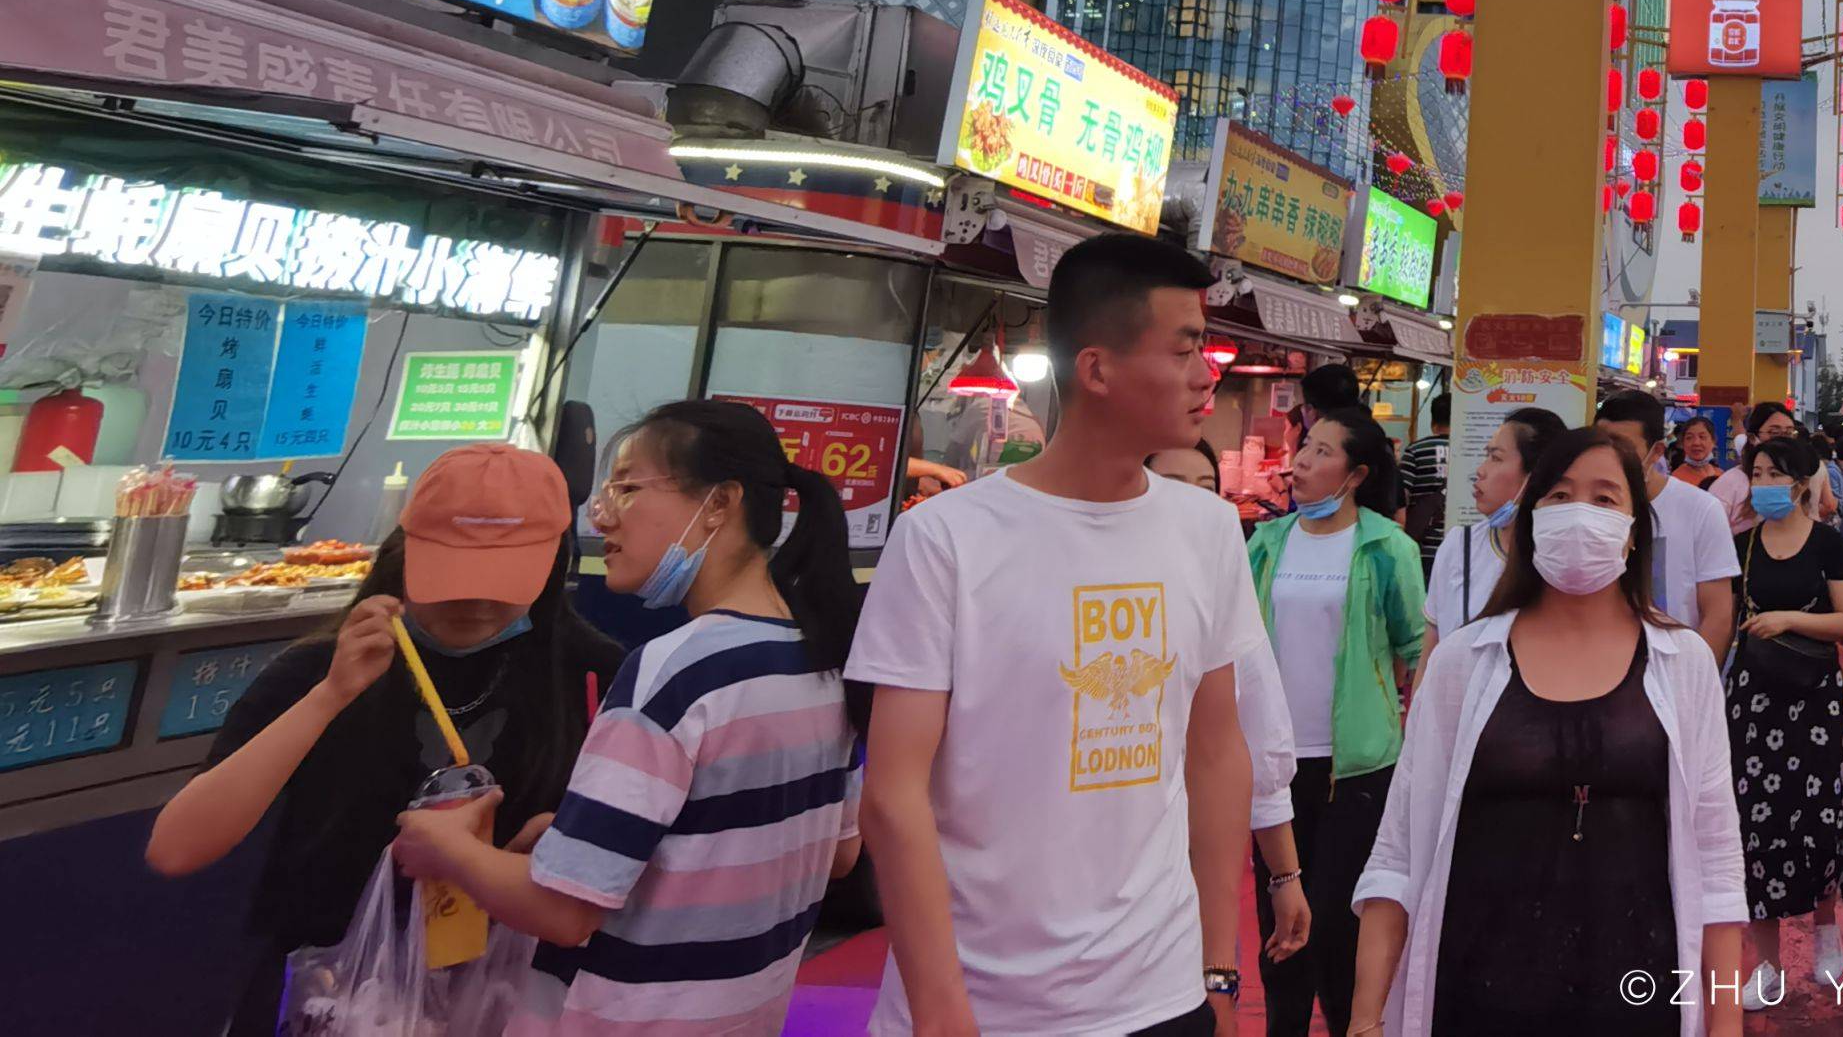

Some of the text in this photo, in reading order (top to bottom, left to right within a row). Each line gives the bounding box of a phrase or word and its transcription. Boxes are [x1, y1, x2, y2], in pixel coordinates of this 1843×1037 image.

[977, 51, 1165, 180] 鸡叉骨 无骨鸡柳
[198, 302, 272, 332] 今日特价
[210, 336, 241, 421] 烤扇贝
[173, 429, 251, 452] 10元4只
[1082, 597, 1158, 644] BOY
[1075, 742, 1157, 775] LODNON
